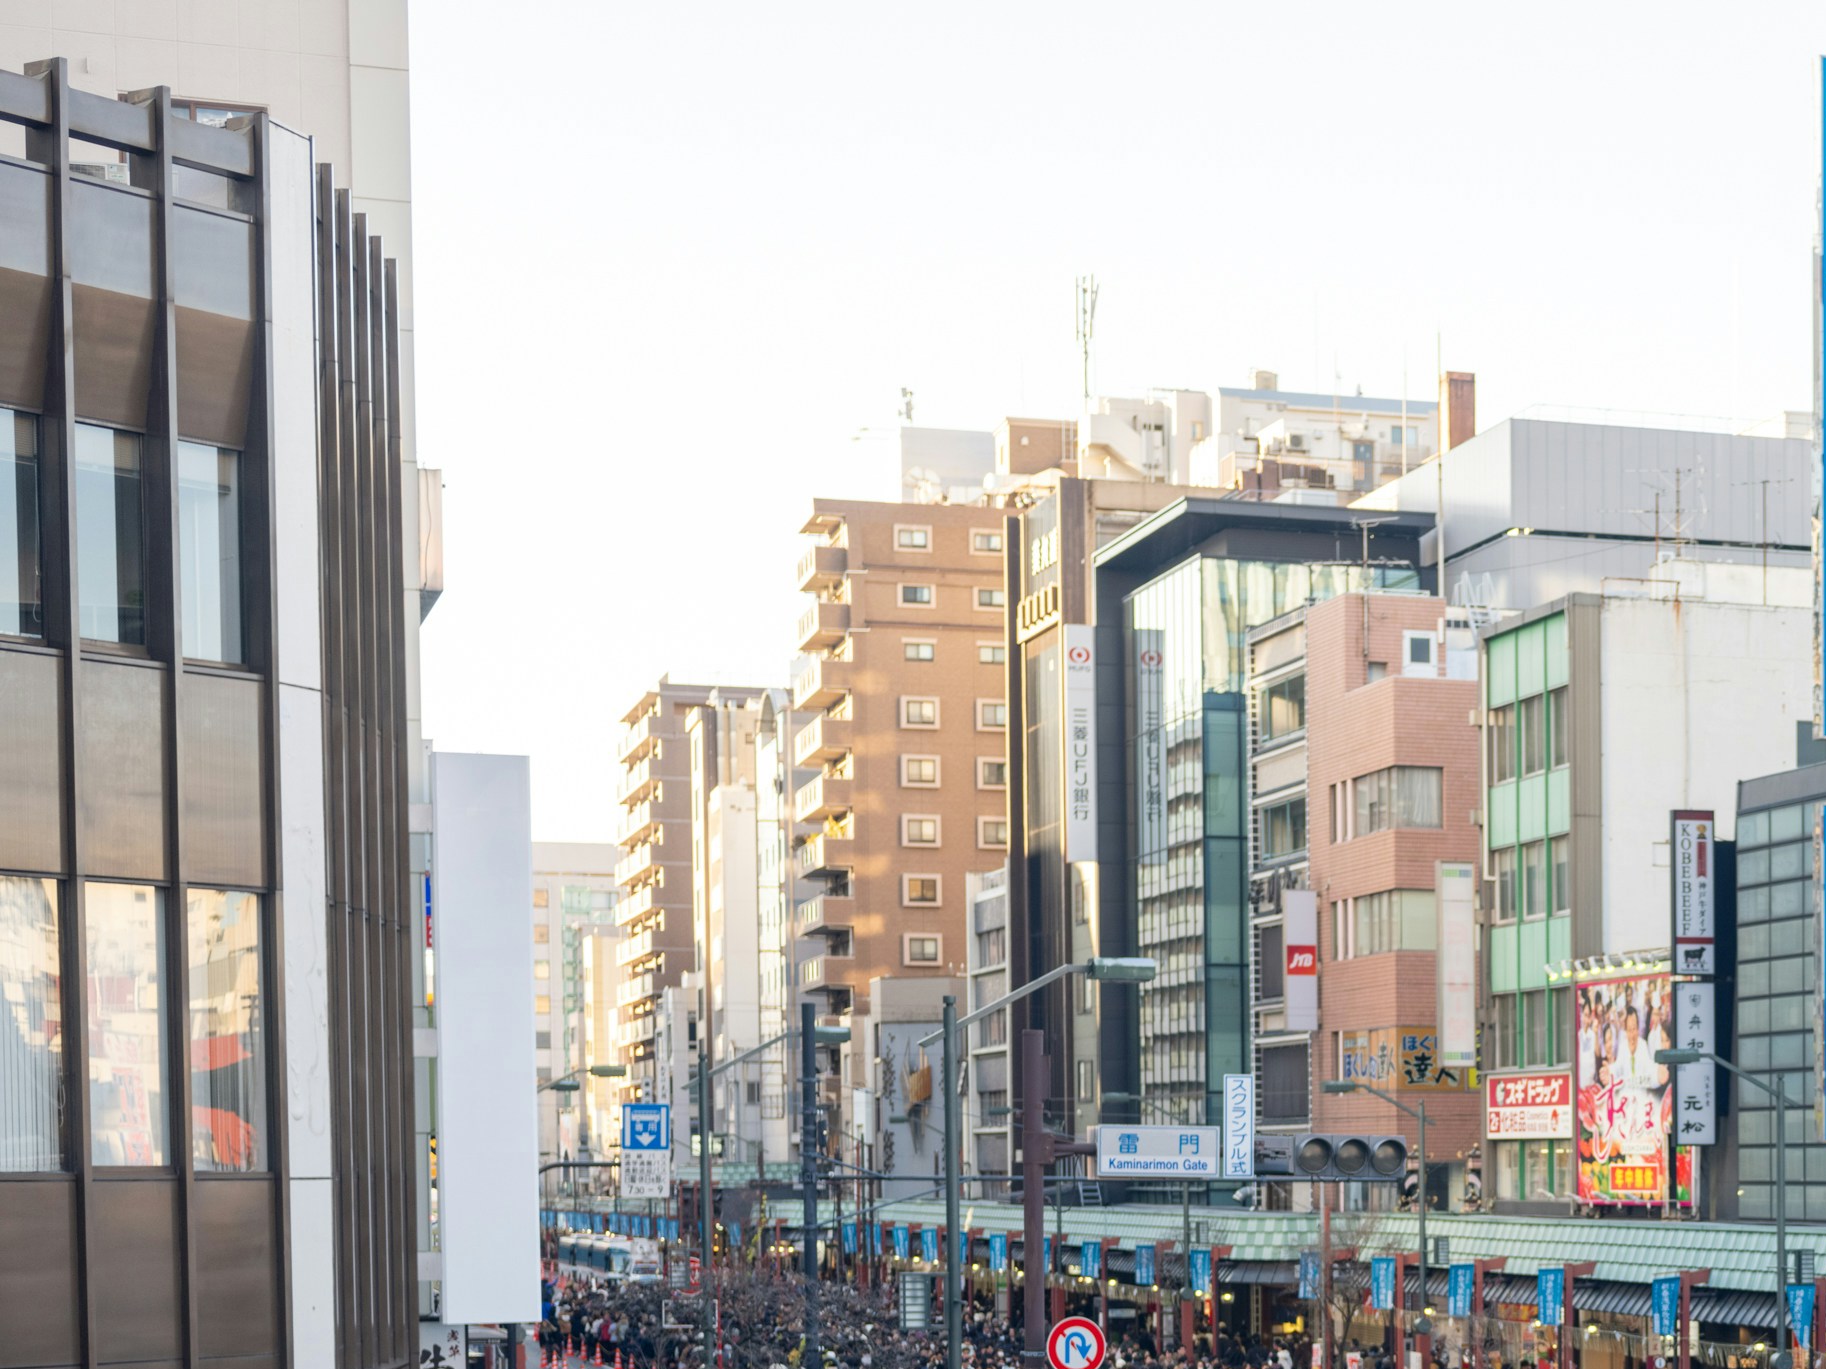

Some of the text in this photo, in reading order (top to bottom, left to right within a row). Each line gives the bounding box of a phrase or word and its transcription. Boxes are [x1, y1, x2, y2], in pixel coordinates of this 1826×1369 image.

[1073, 708, 1089, 821] 三菱UFJ銀行
[1290, 953, 1313, 968] JTB
[1402, 1052, 1459, 1084] 達人
[1505, 1078, 1564, 1105] スギドラッグ
[1231, 1079, 1247, 1174] スクランブル式
[1119, 1133, 1200, 1155] 雷門
[1109, 1158, 1208, 1171] Kaminarimon Gate
